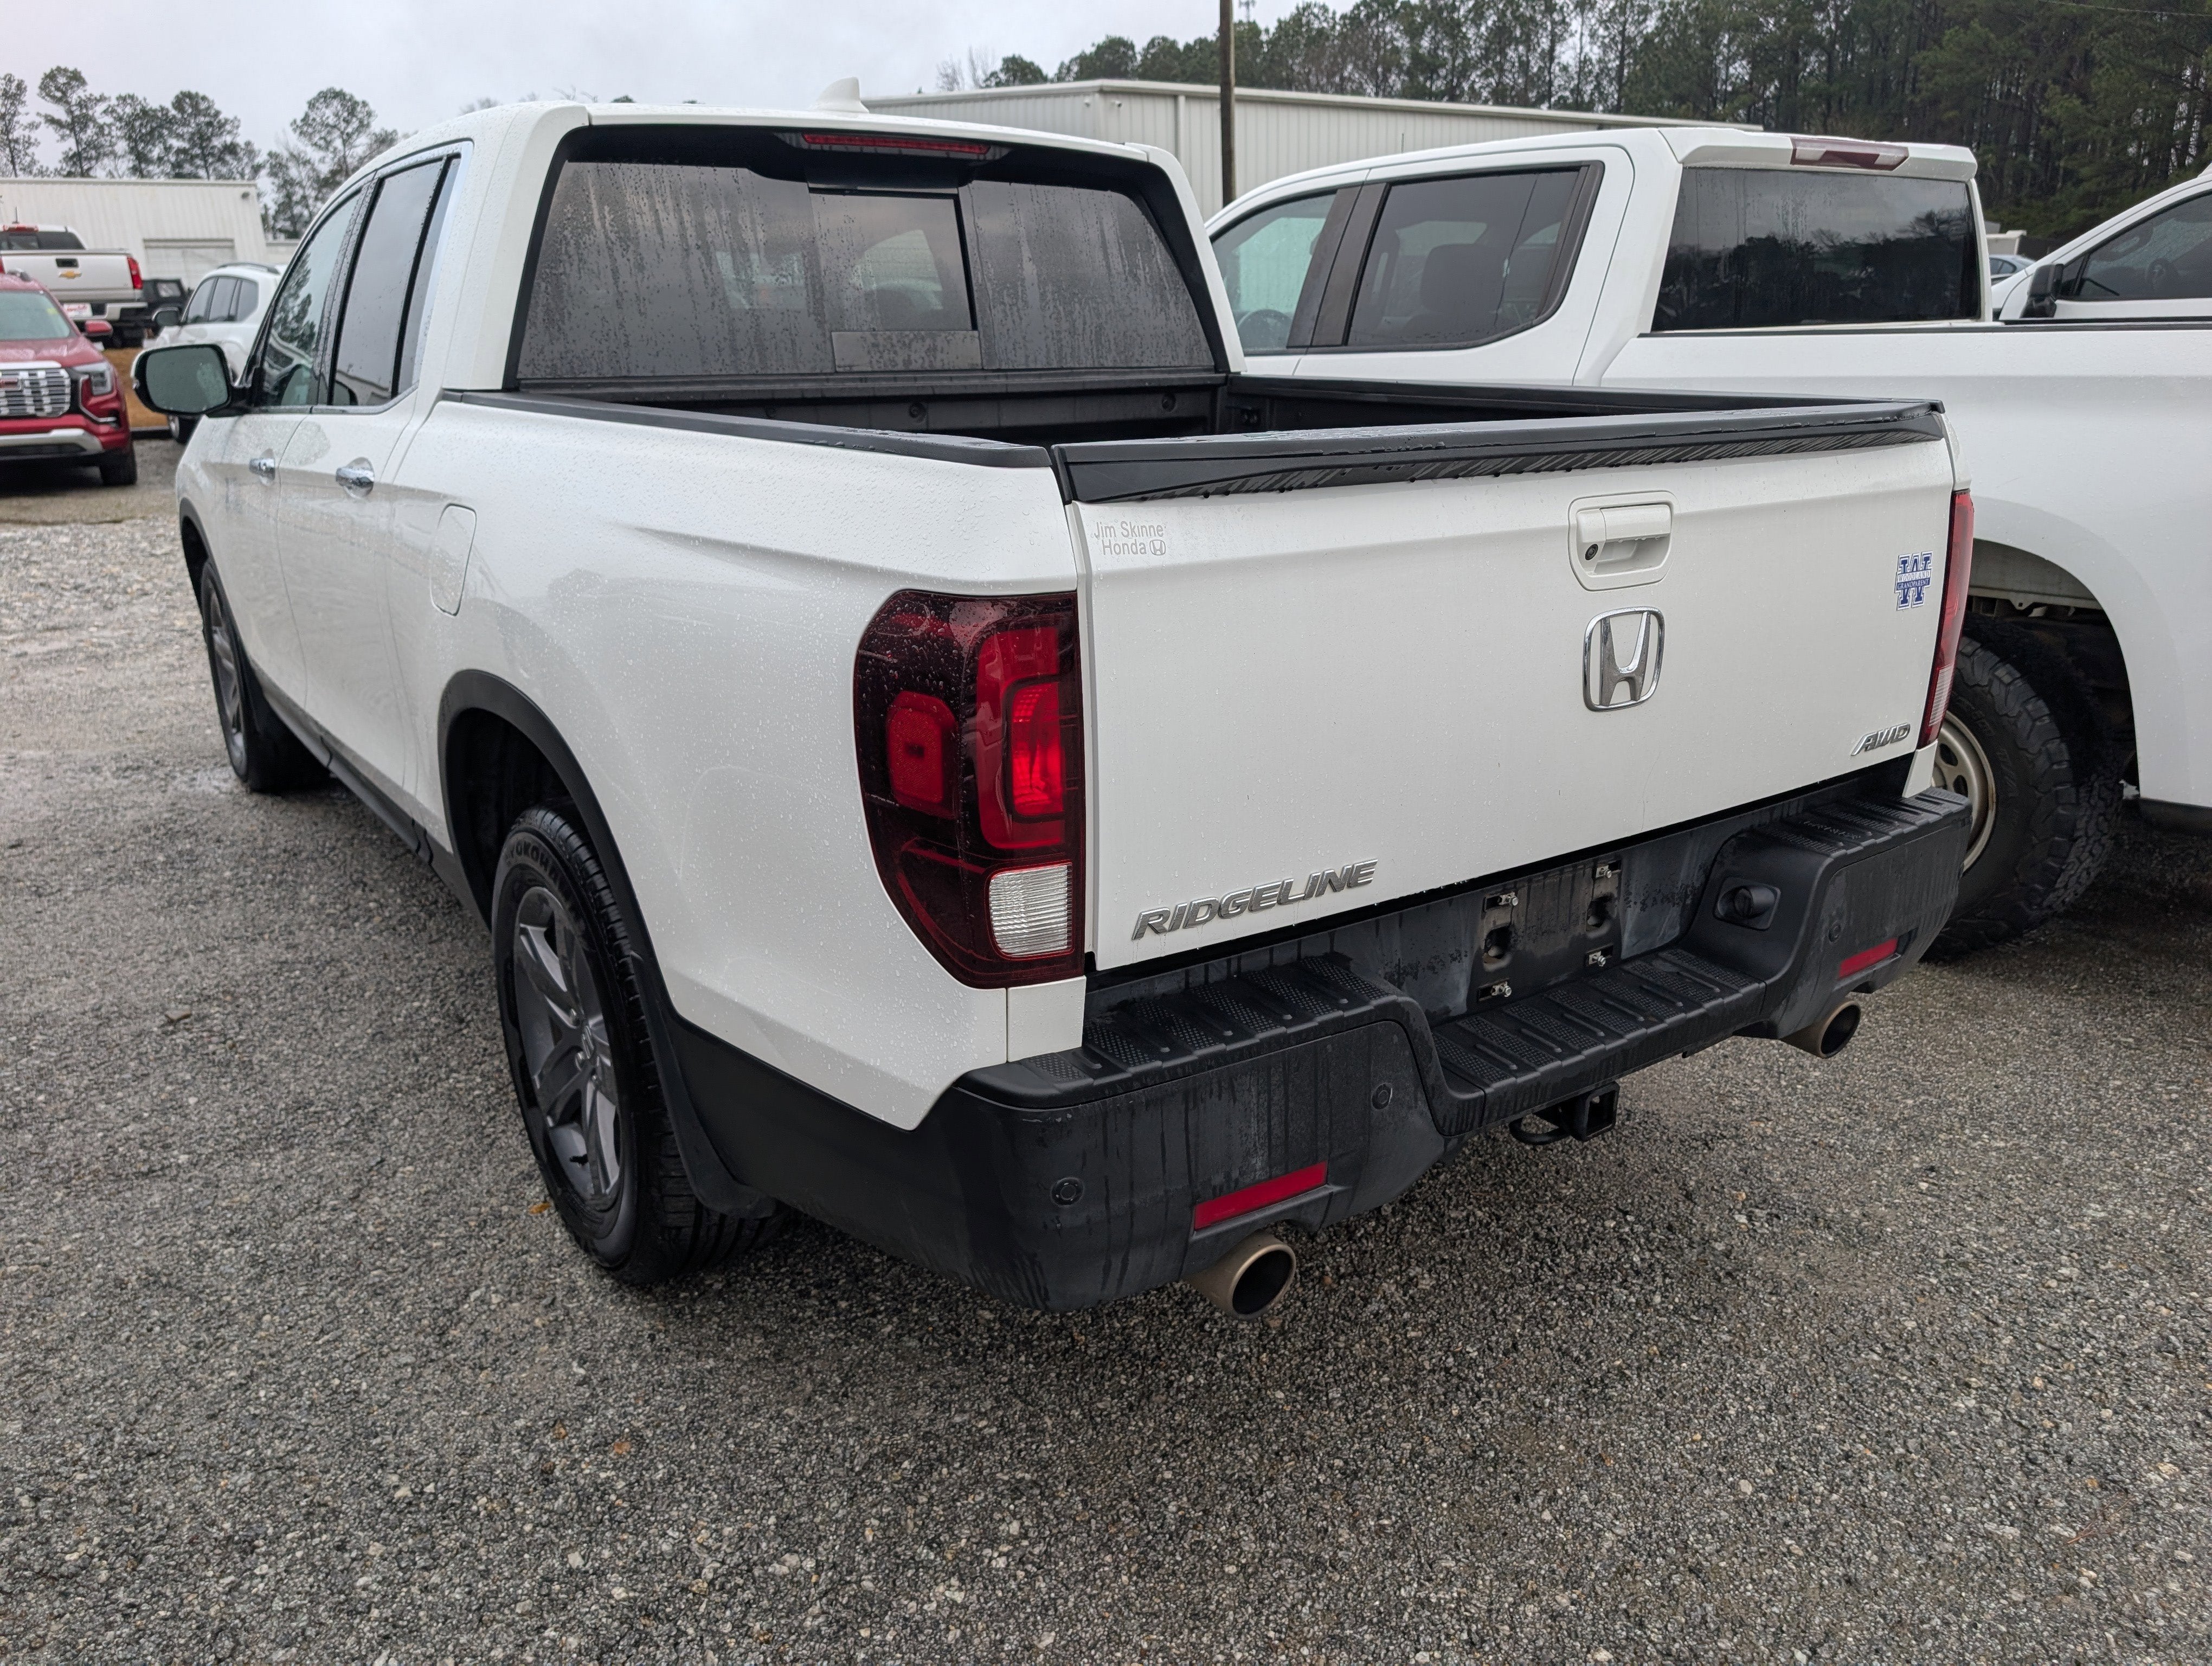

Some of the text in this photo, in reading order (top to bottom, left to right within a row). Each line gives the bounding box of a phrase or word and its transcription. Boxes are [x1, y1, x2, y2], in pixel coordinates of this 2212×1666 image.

[1094, 521, 1166, 539] Jim Skinne
[1102, 539, 1146, 555] Honda
[1898, 579, 1930, 589] GRANDPARENT
[1899, 571, 1930, 581] WOODLAND
[1850, 723, 1911, 756] AWD
[1131, 858, 1378, 940] RIDGELINE
